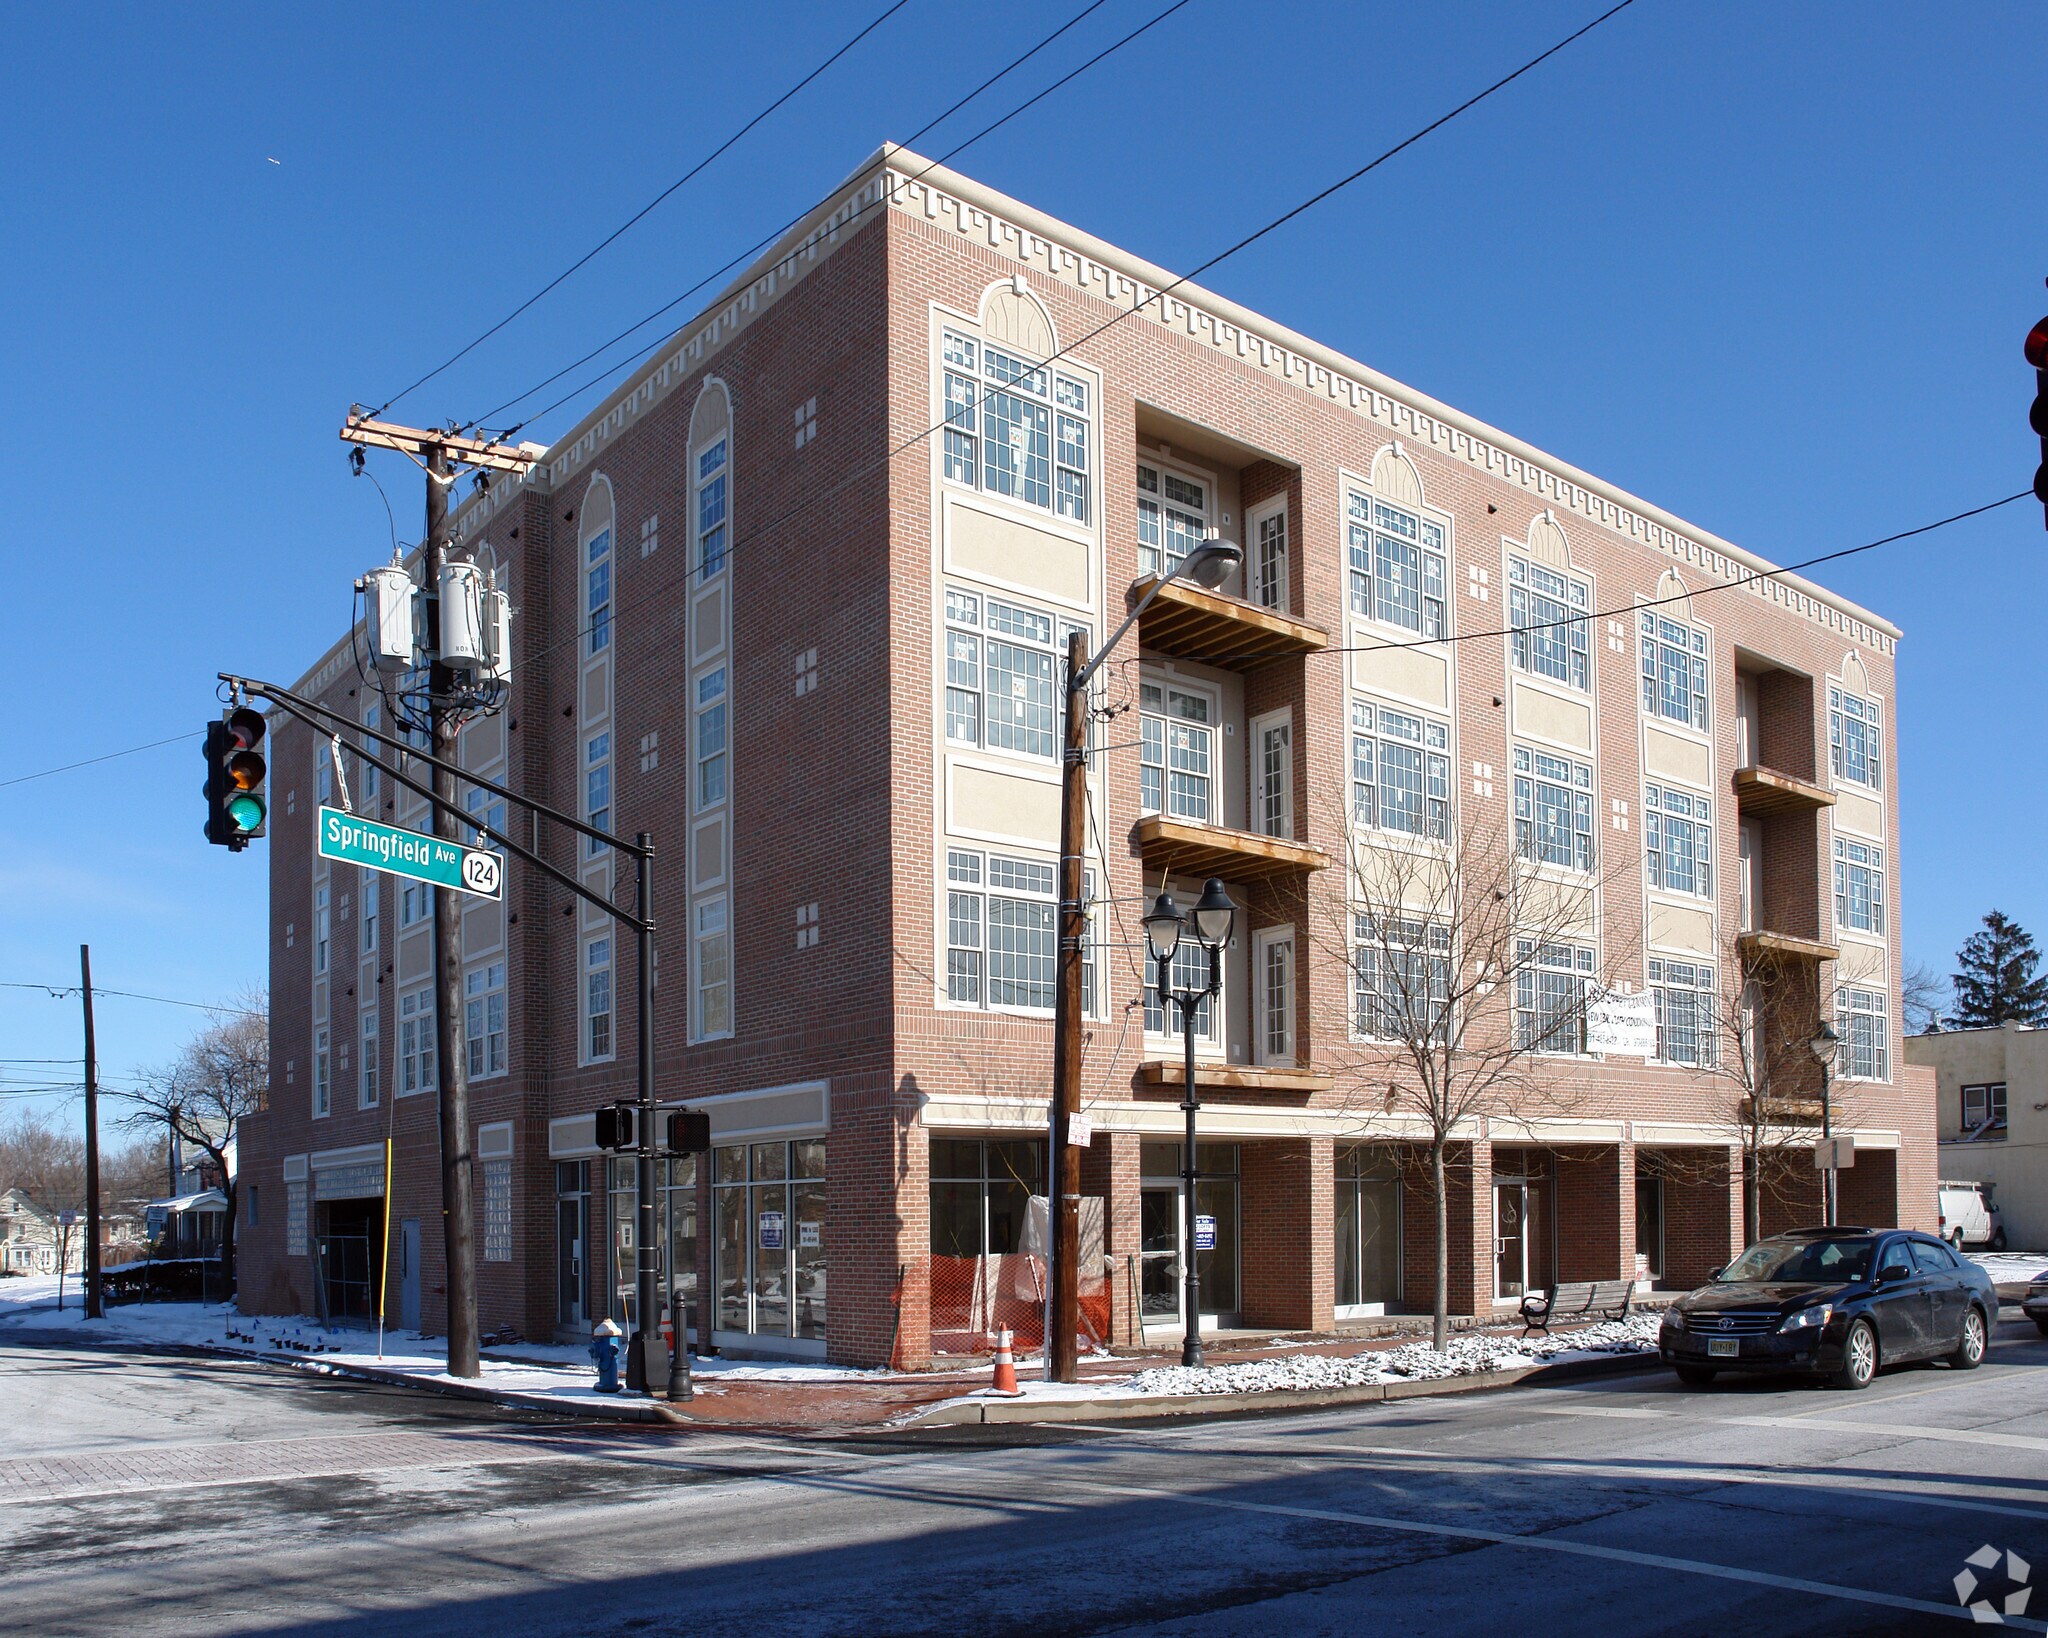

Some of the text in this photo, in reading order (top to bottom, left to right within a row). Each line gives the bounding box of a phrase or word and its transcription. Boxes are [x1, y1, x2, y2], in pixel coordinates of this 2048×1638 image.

[327, 816, 456, 867] Springfield Ave
[468, 859, 494, 886] 124
